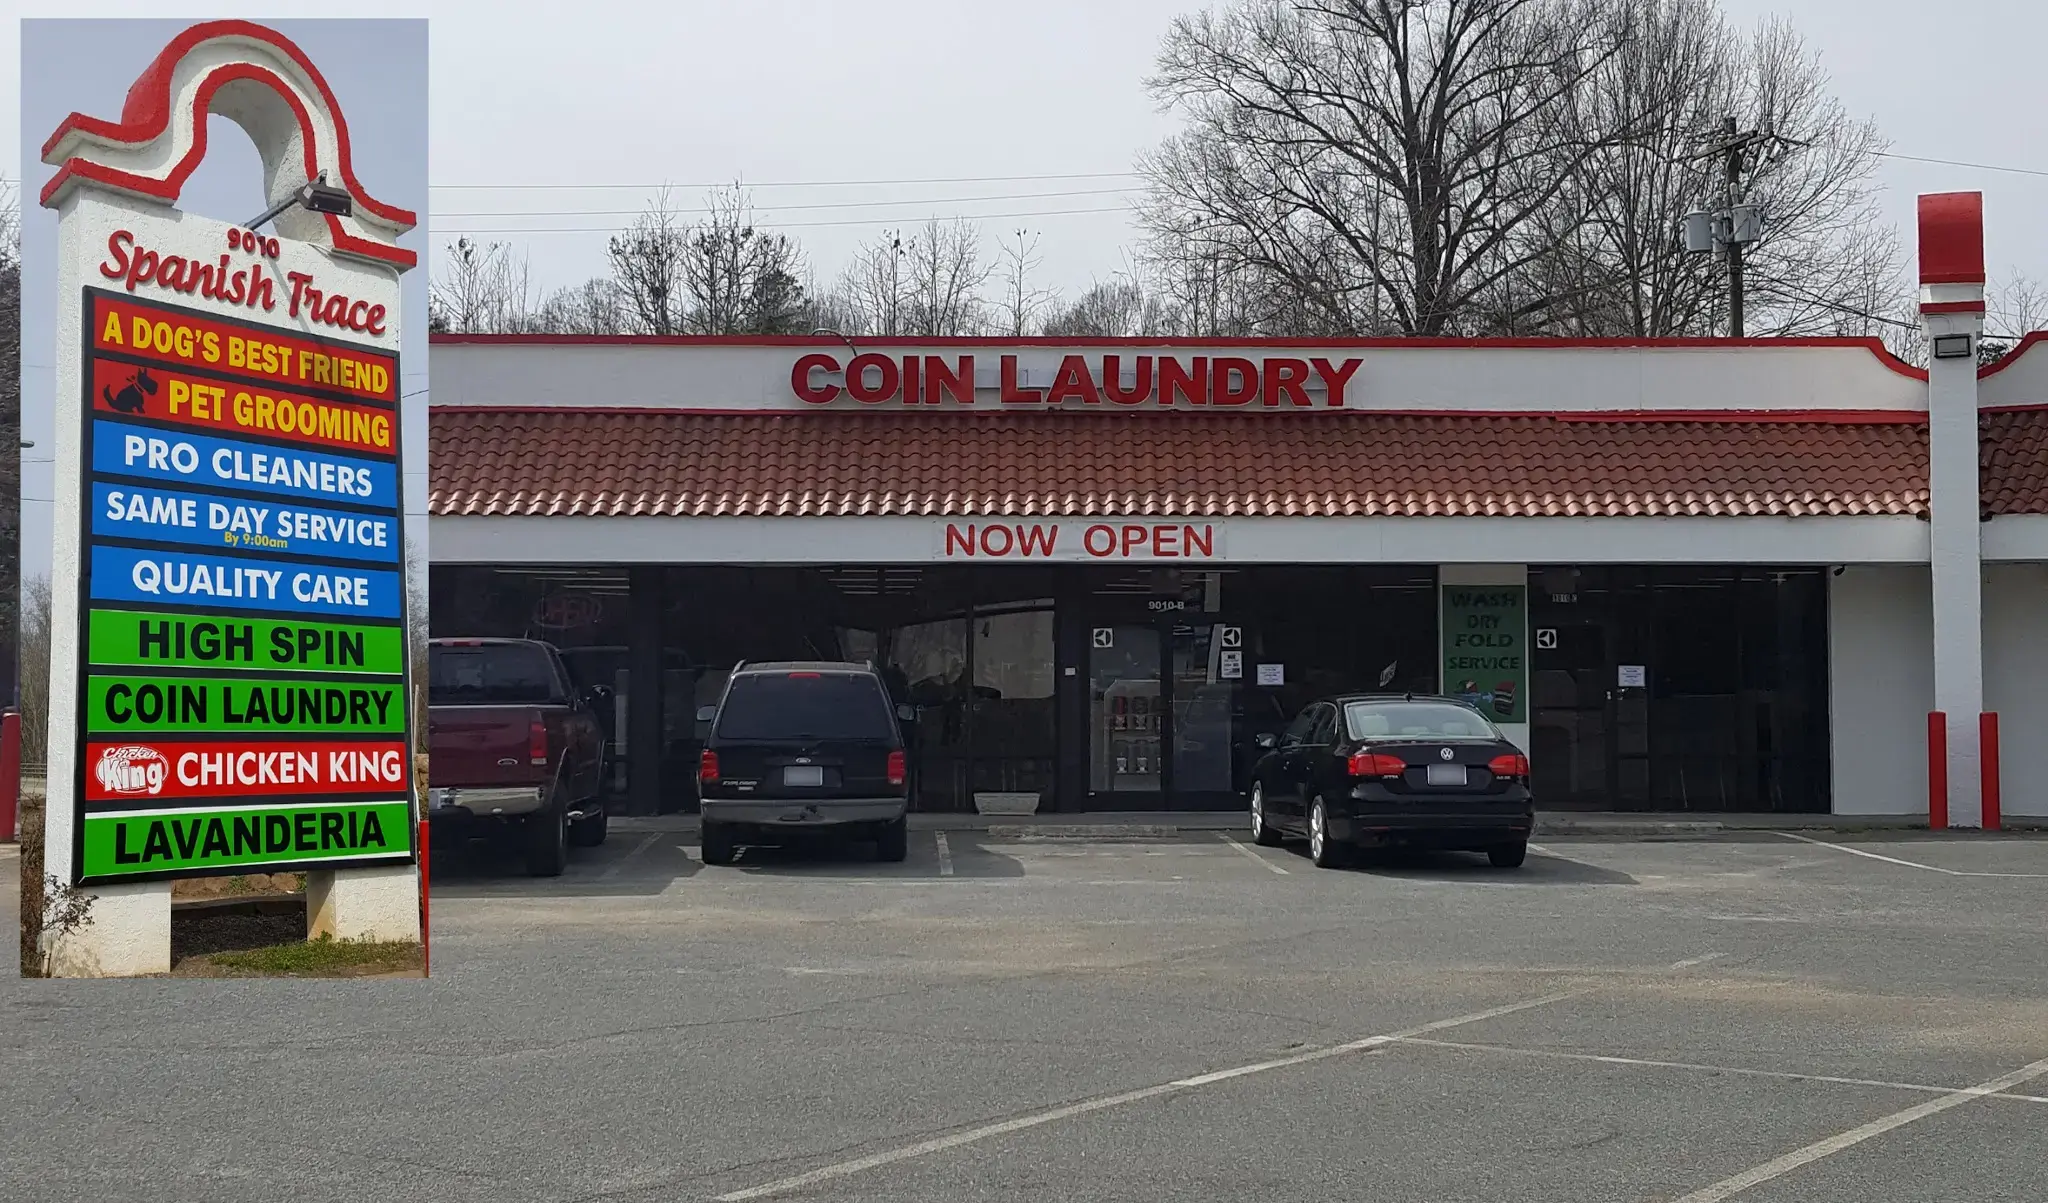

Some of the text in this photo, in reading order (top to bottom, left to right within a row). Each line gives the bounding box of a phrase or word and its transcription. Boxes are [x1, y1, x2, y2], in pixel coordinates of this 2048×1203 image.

[227, 228, 280, 258] 9010
[100, 229, 387, 336] Spanish Trace
[103, 311, 389, 394] A DOG'S BEST FRIEND
[791, 353, 1364, 408] COIN LAUNDRY
[169, 379, 390, 448] PET GROOMING
[125, 435, 373, 497] PRO CLEANERS
[106, 491, 387, 547] SAME DAY SERVICE
[223, 531, 288, 549] By 9:00am
[945, 523, 1213, 558] NOW OPEN
[132, 559, 369, 606] QUALITY CARE
[1452, 592, 1517, 608] WASH
[1455, 633, 1514, 647] FOLD
[1467, 614, 1502, 629] DRY
[139, 619, 365, 666] HIGH SPIN
[1449, 656, 1520, 670] SERVICE
[105, 683, 393, 726] COIN LAUNDRY
[103, 746, 159, 760] Chicken
[177, 750, 401, 787] CHICKEN KING
[103, 758, 162, 795] King
[115, 810, 387, 865] LAVANDERIA
